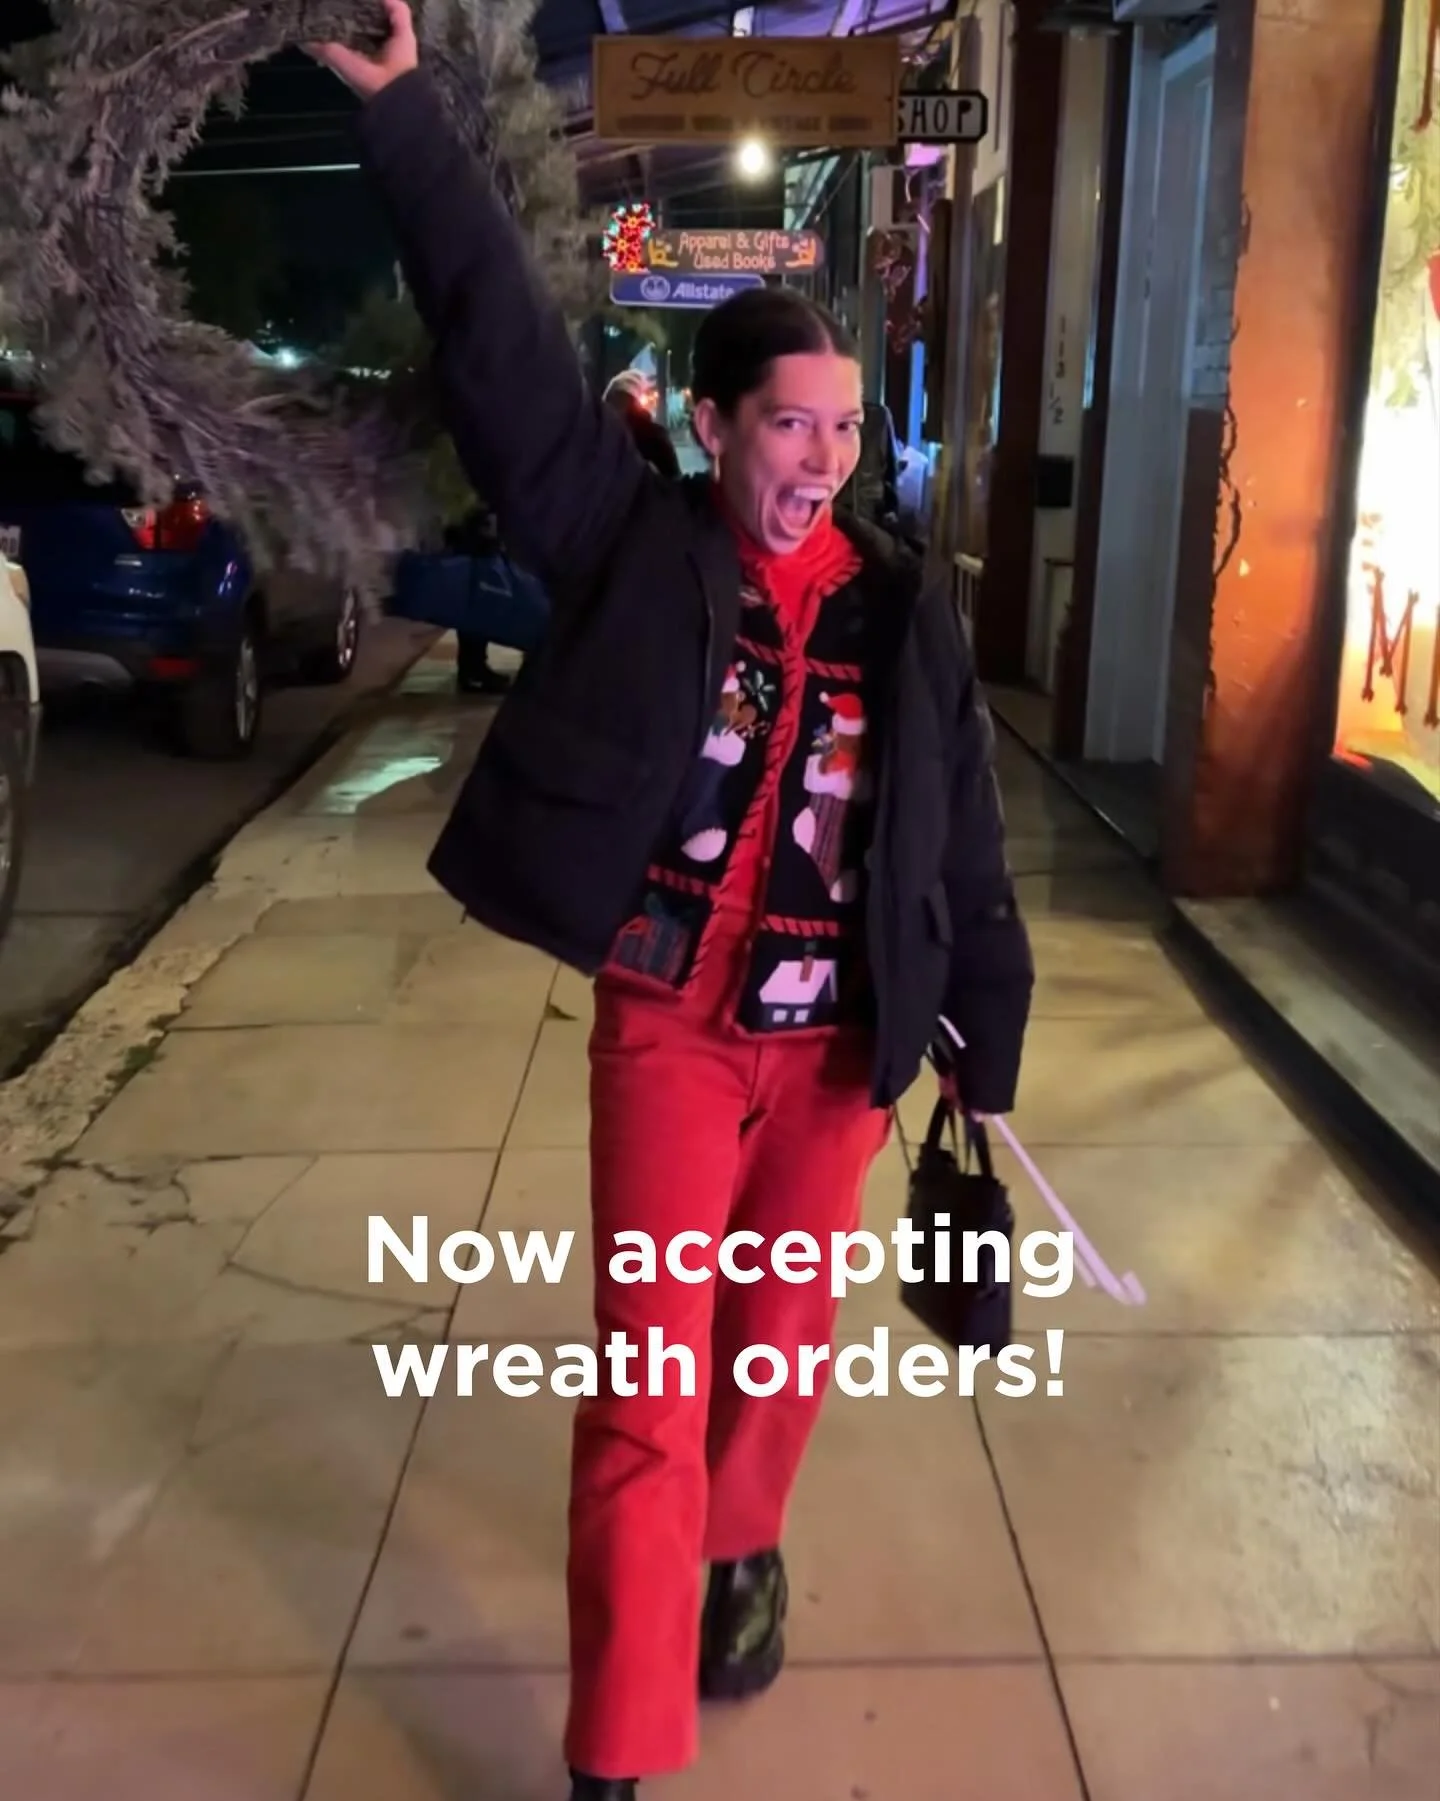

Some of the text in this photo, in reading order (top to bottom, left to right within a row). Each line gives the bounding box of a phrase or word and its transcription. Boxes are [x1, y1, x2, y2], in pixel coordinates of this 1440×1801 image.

[630, 50, 858, 100] Full Circle
[678, 231, 789, 254] Apparel & Gifts
[693, 254, 776, 271] Used Books
